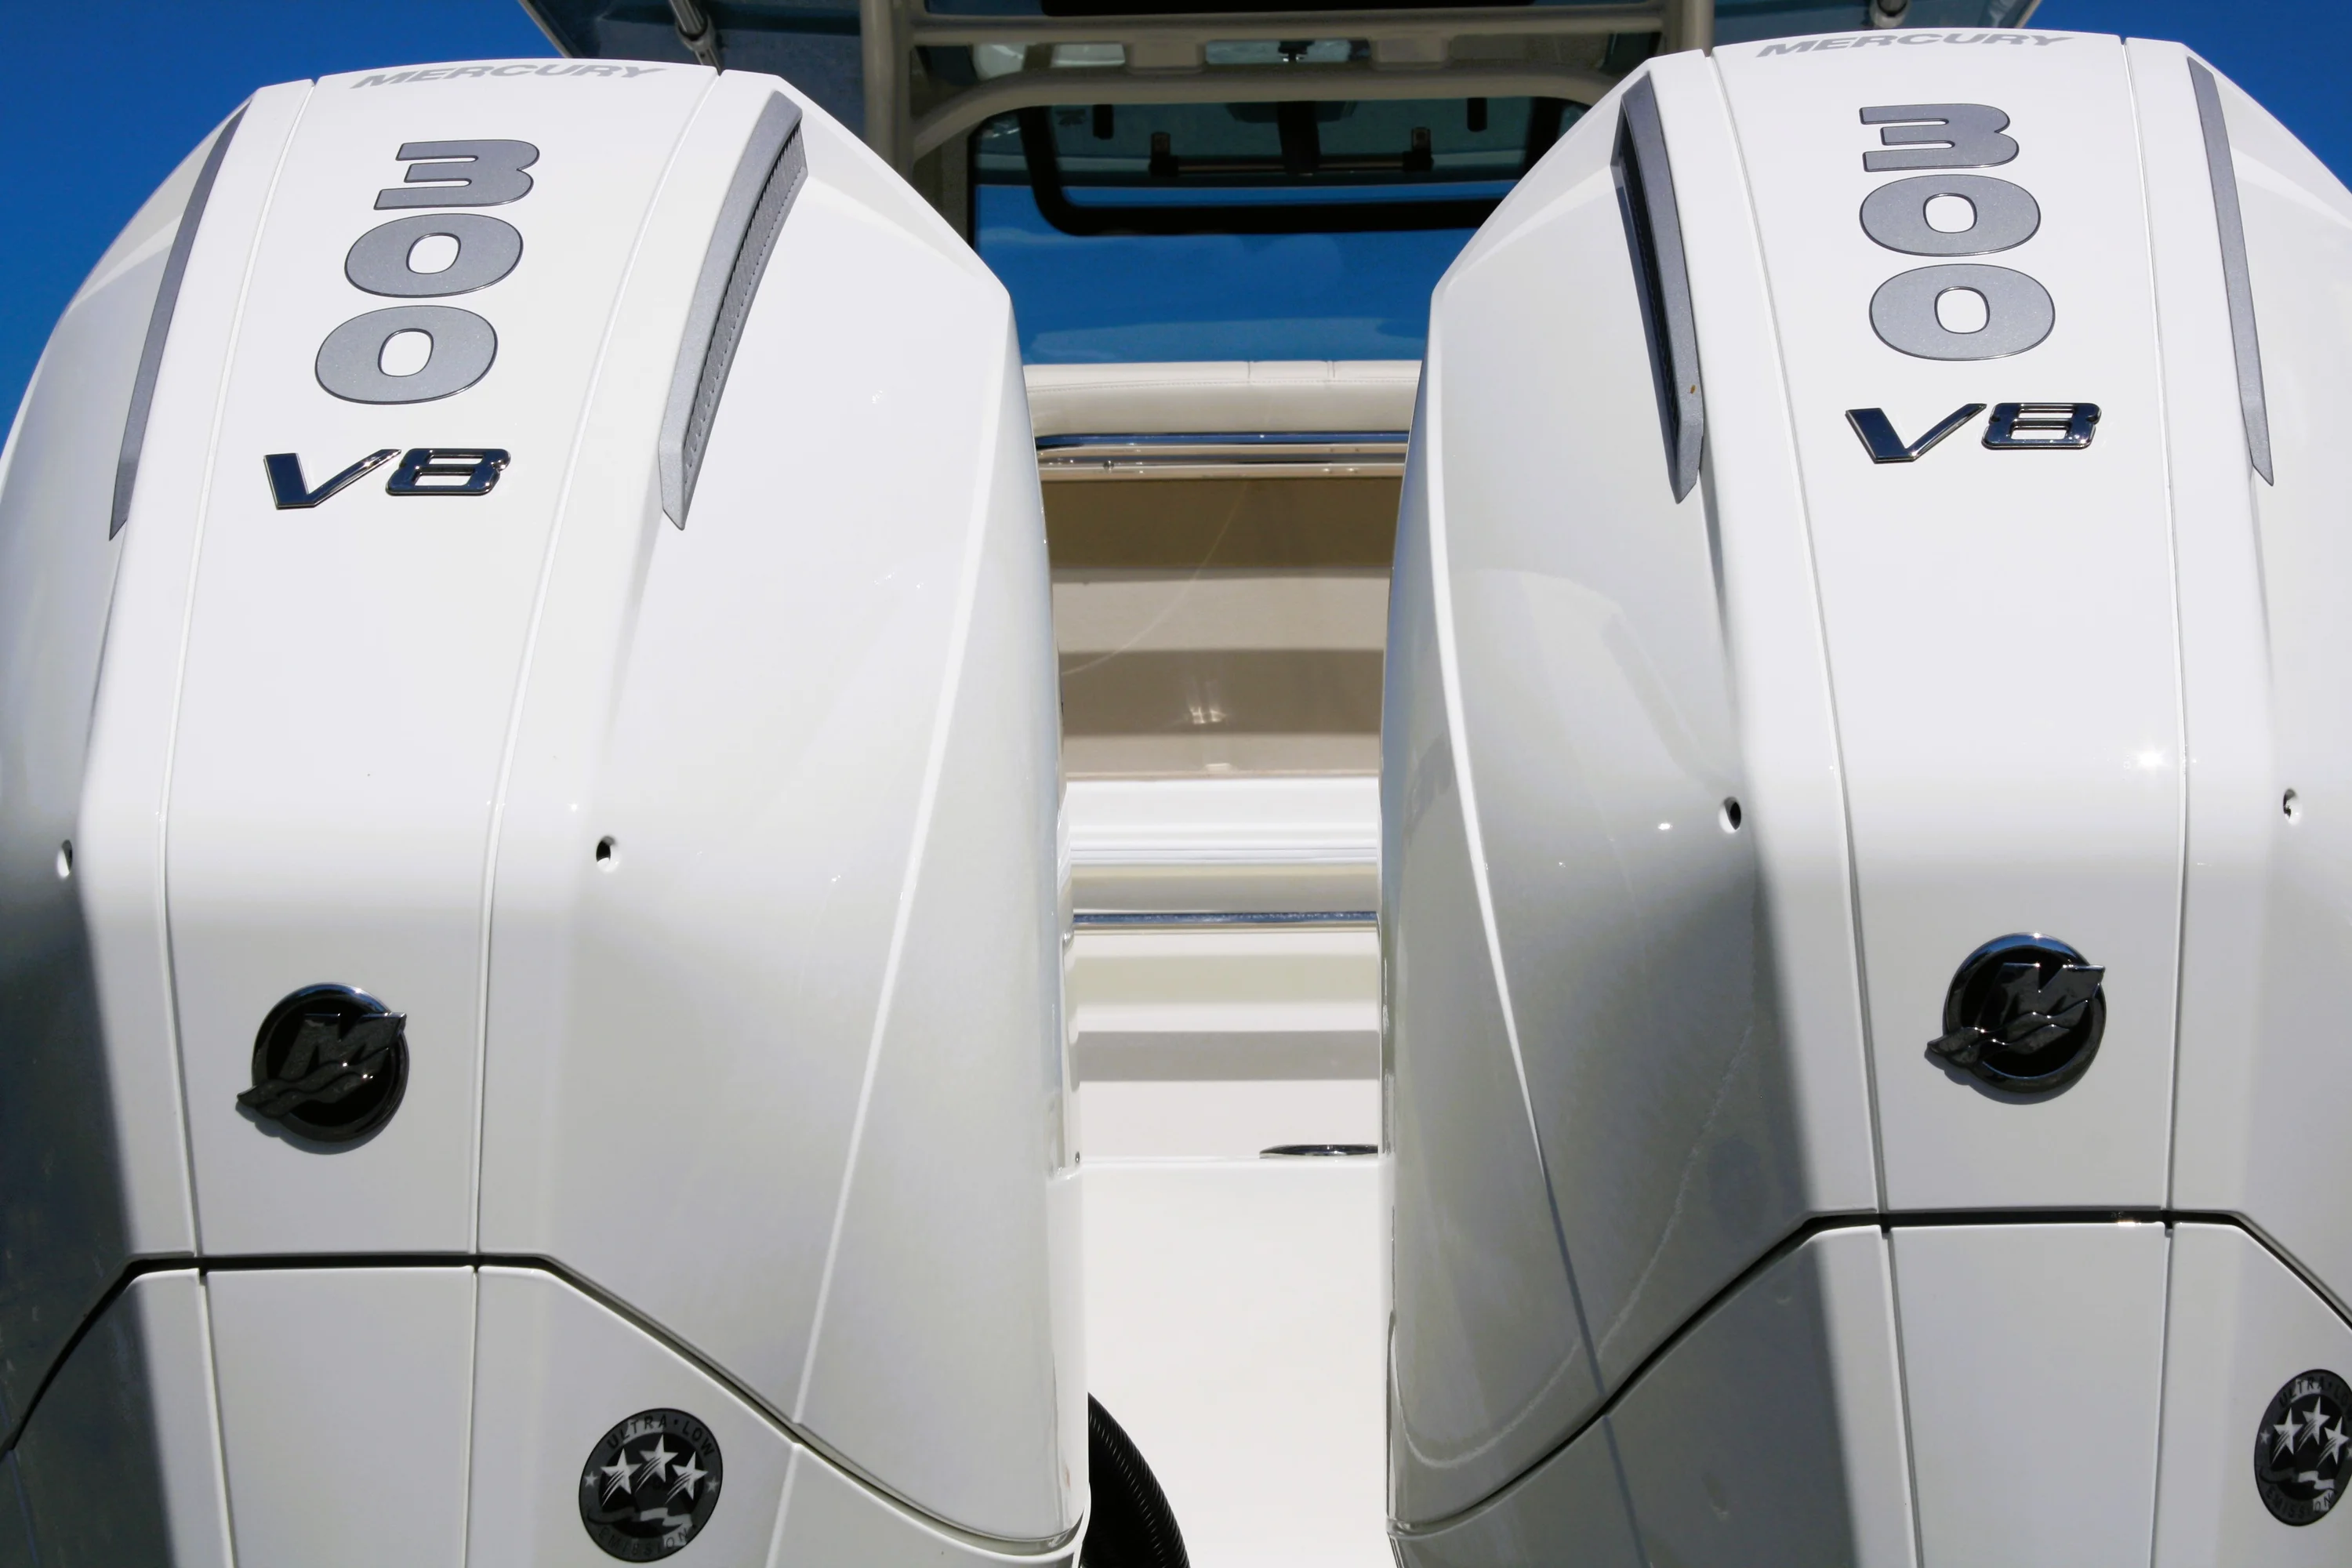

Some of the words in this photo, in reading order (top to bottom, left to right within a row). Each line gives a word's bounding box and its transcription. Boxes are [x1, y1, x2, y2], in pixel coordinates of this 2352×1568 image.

[1755, 33, 2074, 57] MERCURY
[350, 64, 667, 89] MERCURY
[1859, 103, 2056, 361] 300
[315, 139, 539, 405] 300
[1846, 402, 2101, 463] V8
[263, 448, 510, 510] V8
[2278, 1375, 2325, 1409] ULTRA
[606, 1414, 666, 1450] ULTRA
[681, 1420, 715, 1457] LOW
